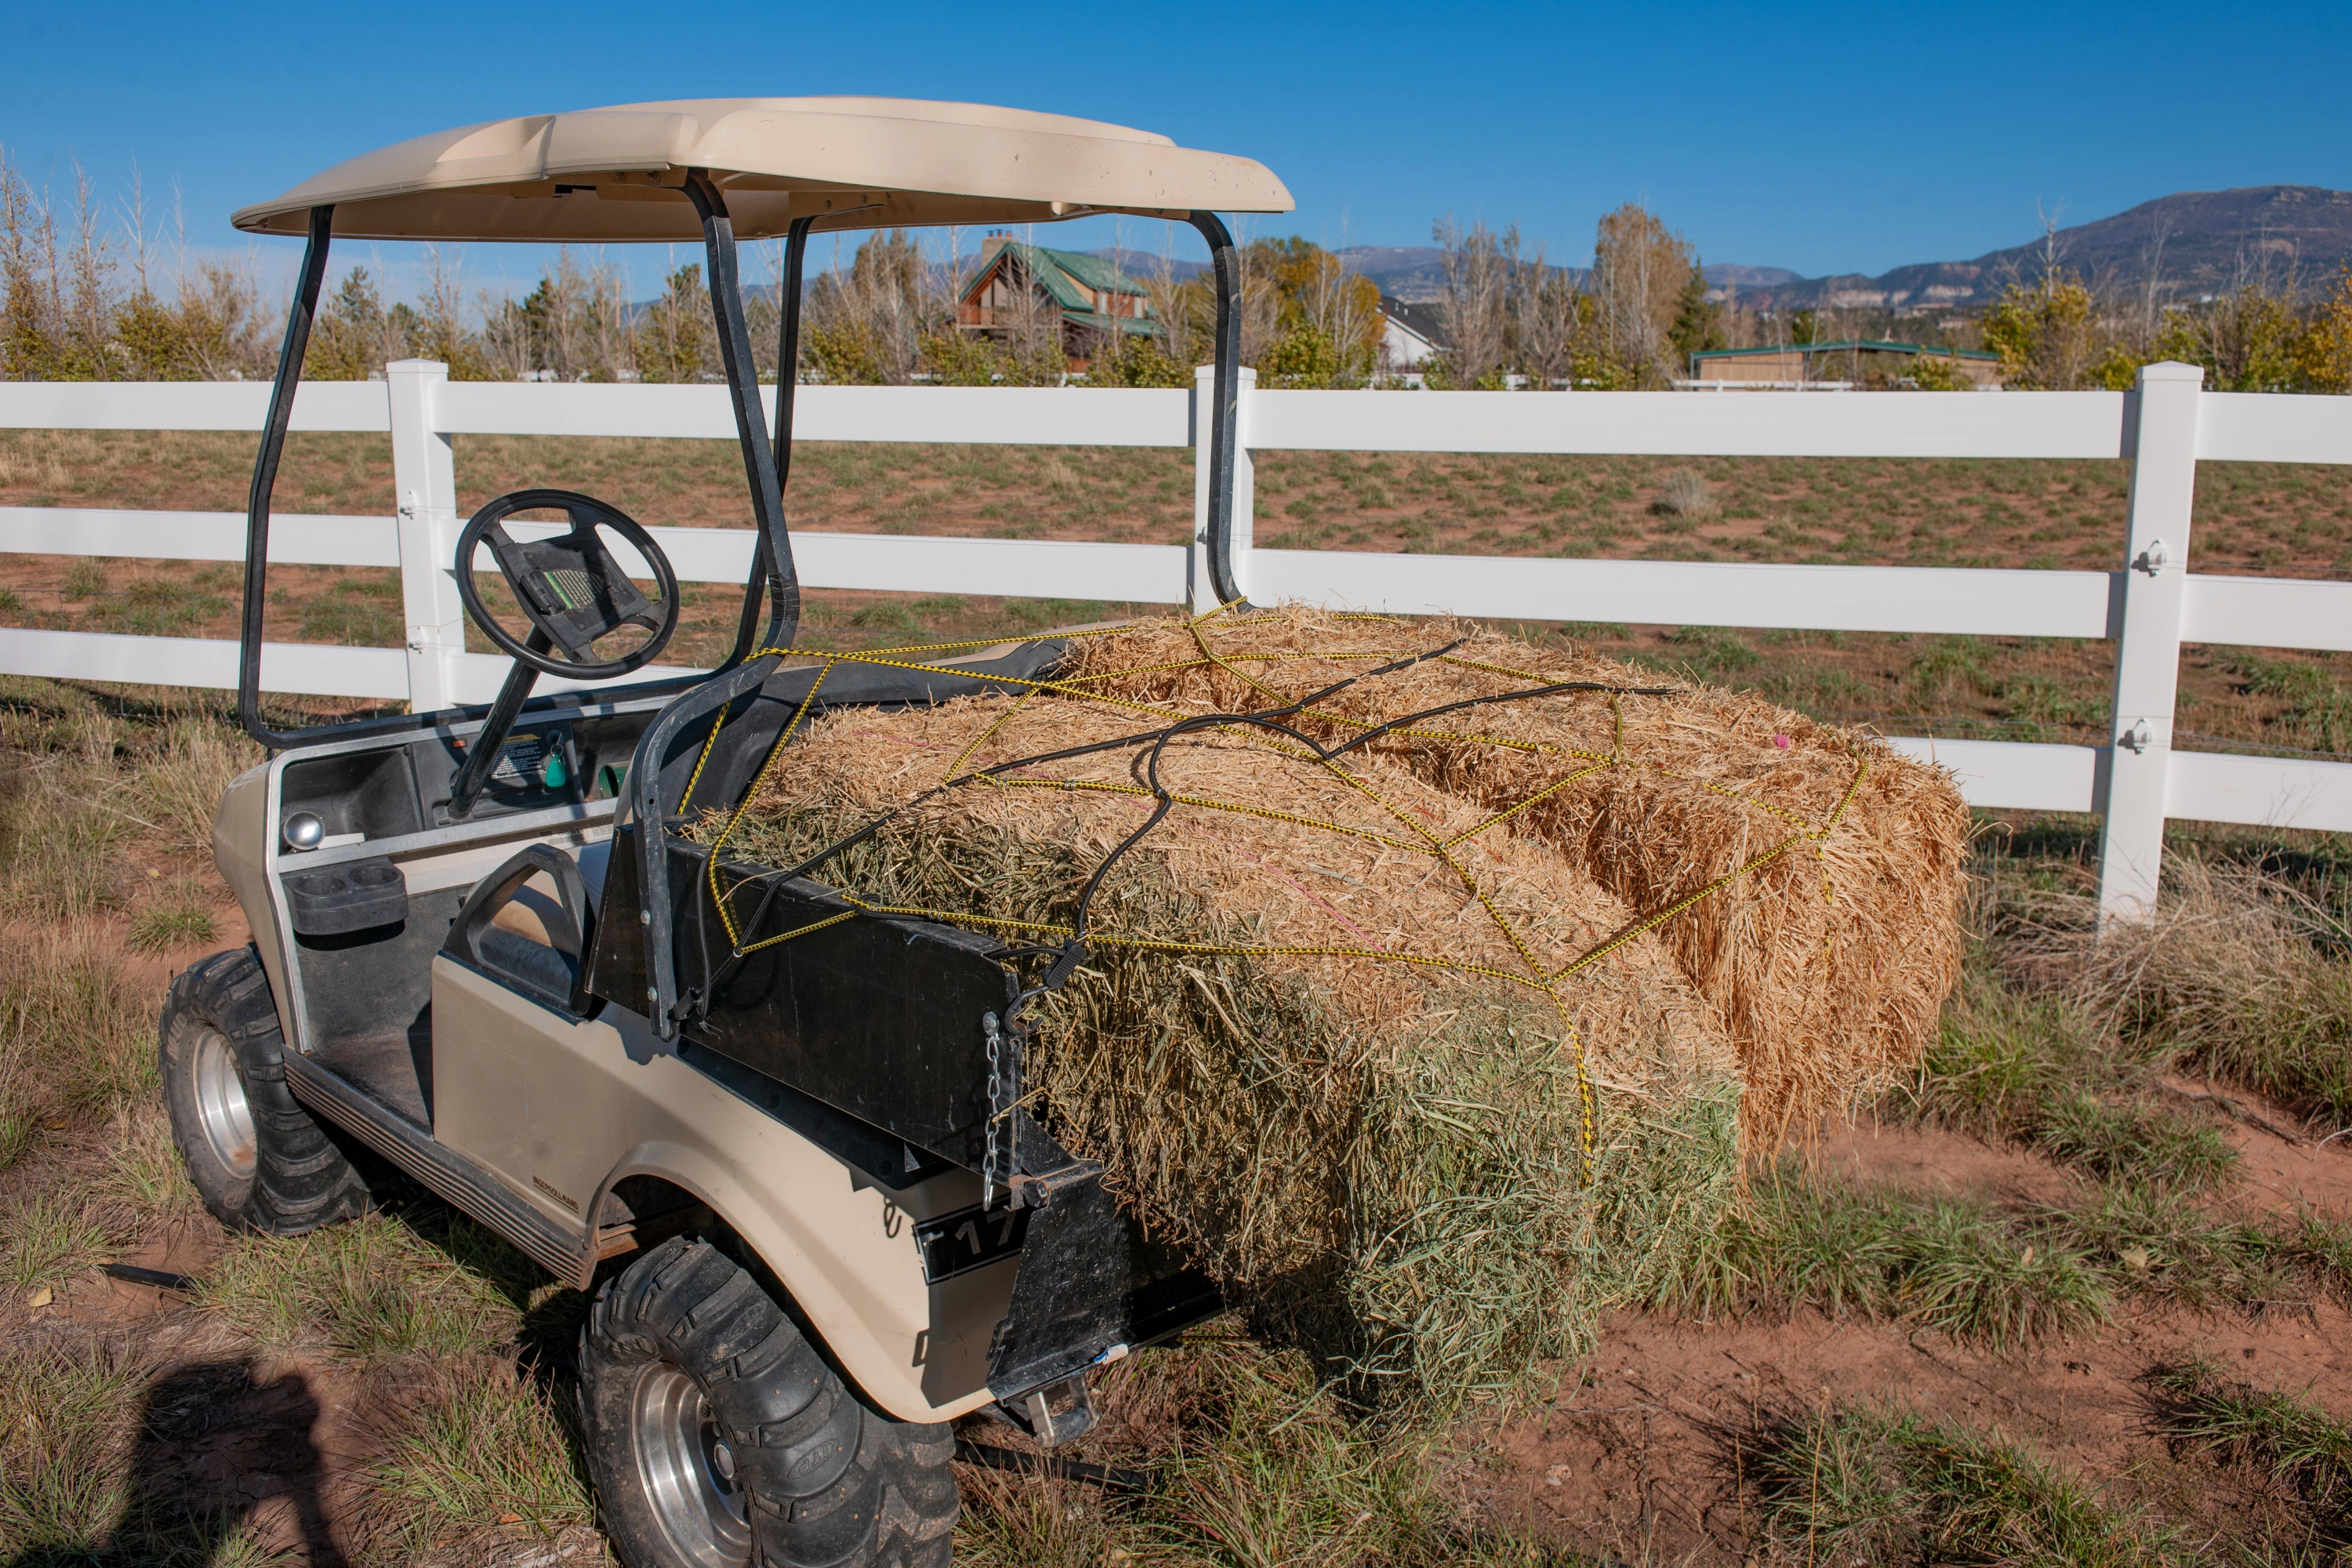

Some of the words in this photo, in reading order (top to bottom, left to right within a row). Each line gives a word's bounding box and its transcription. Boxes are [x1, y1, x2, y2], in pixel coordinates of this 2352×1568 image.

[167, 1012, 188, 1061] MUD
[533, 1175, 579, 1210] INGERSOLL-RAND
[954, 1210, 1017, 1254] 17
[798, 1443, 829, 1474] ITP
